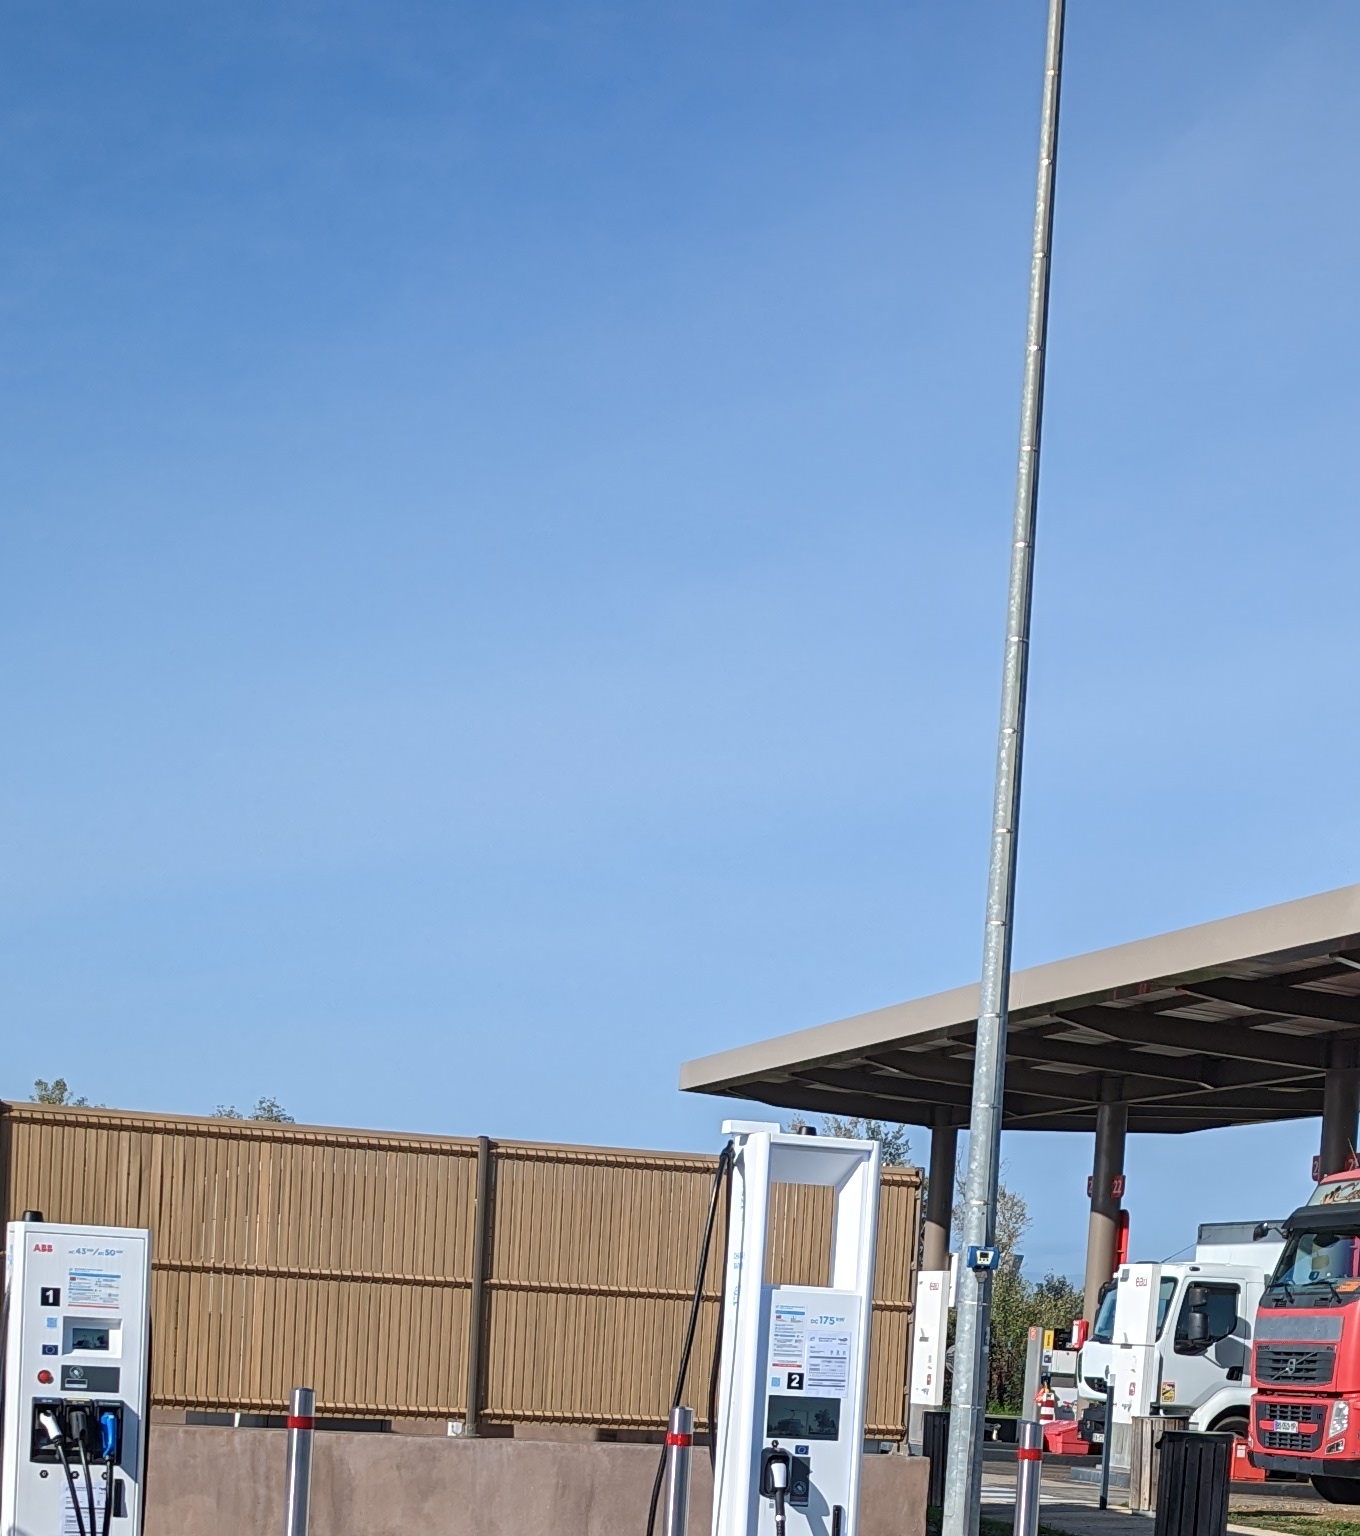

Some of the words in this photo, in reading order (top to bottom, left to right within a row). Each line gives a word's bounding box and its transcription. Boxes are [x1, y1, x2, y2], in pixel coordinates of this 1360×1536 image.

[33, 1244, 53, 1252] ABB
[45, 1289, 54, 1304] 1
[790, 1374, 800, 1387] 2
